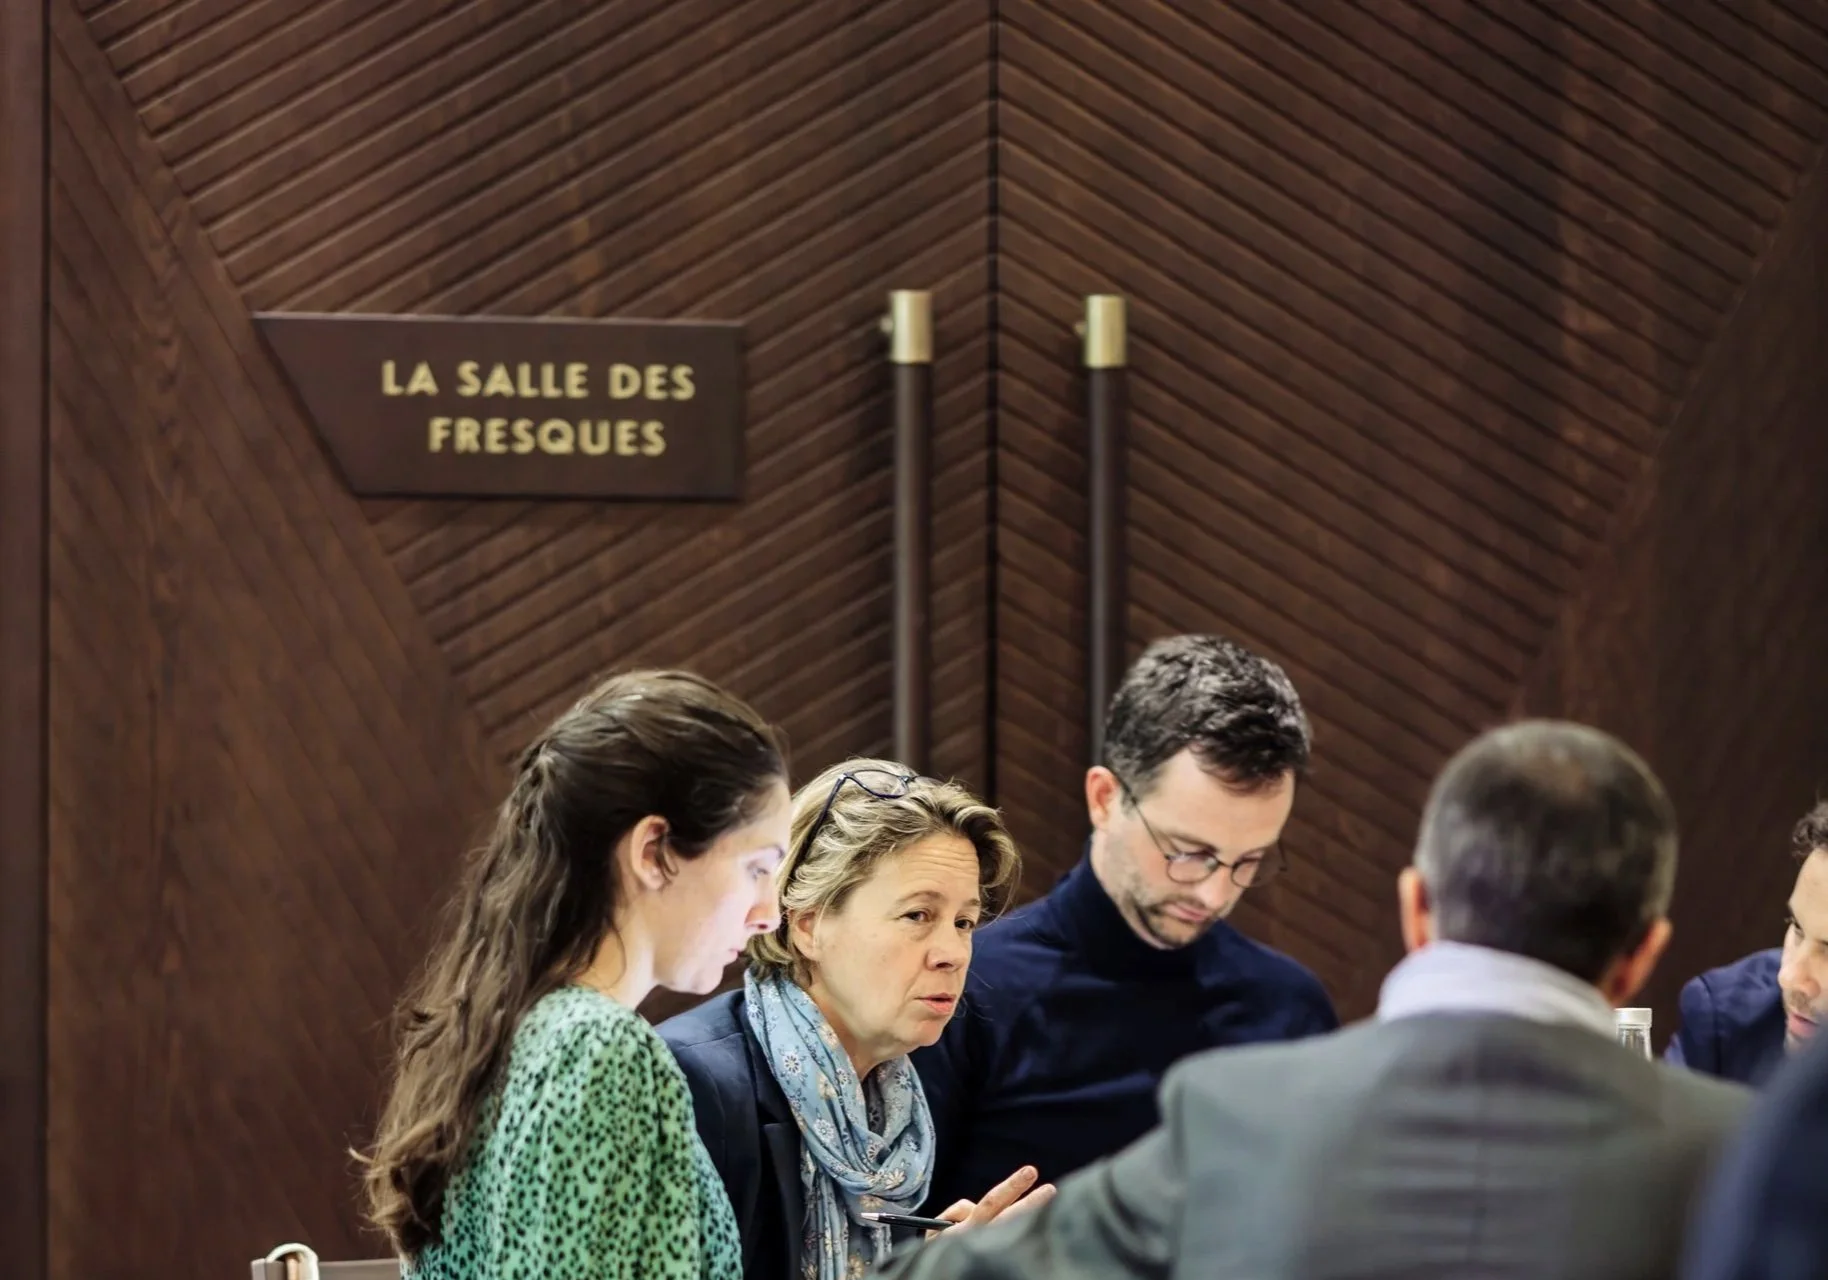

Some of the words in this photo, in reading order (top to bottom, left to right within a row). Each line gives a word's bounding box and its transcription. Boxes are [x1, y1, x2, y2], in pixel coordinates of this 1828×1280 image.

[381, 361, 438, 396] LA
[457, 361, 589, 398] SALLE
[608, 364, 695, 400] DES
[429, 417, 666, 456] FRESQUES
